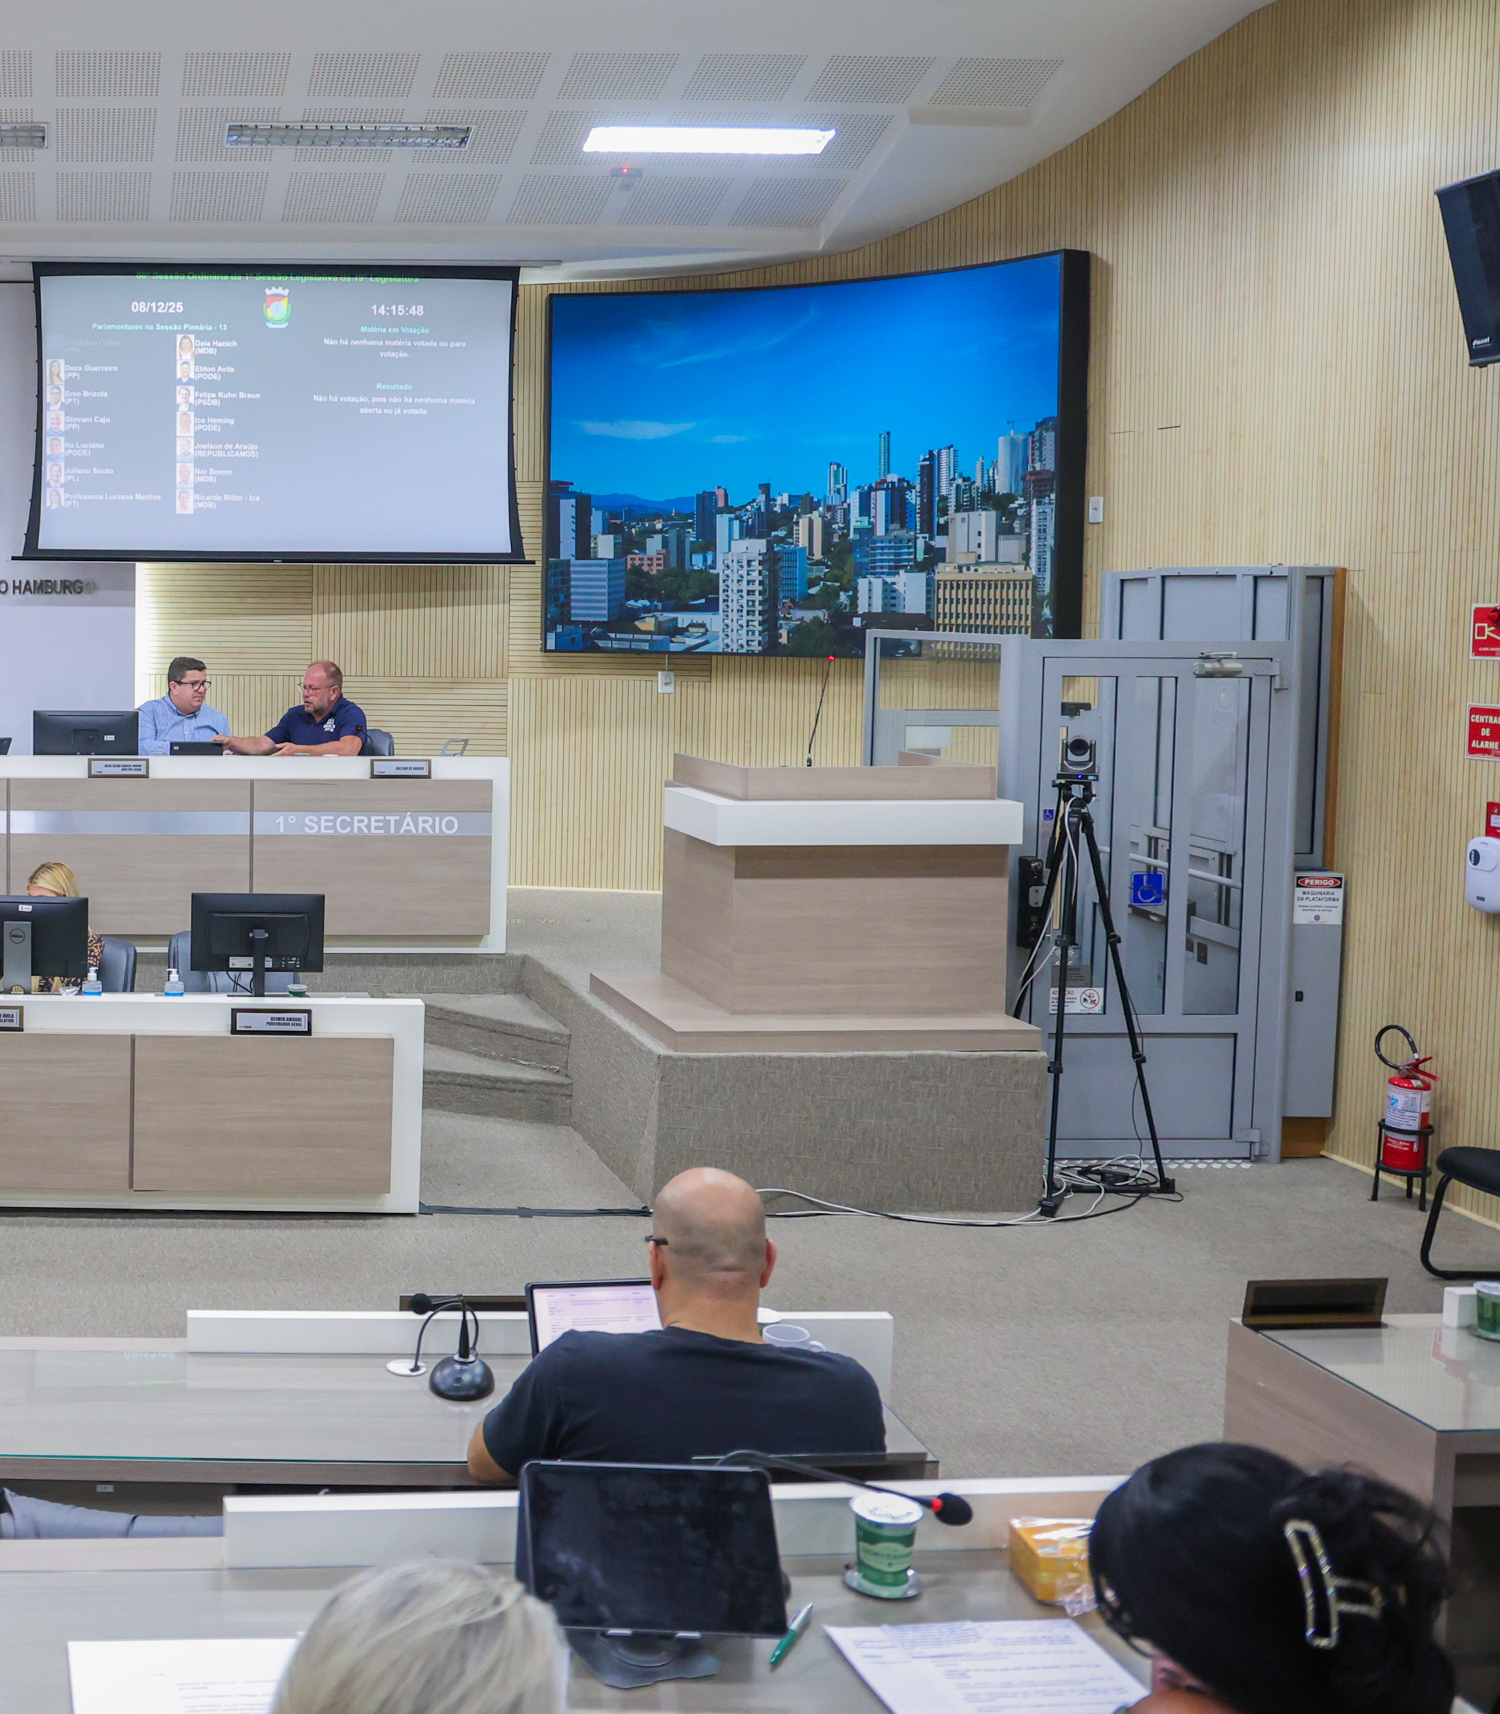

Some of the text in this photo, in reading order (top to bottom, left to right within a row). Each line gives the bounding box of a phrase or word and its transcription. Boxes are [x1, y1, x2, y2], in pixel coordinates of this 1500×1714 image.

[131, 301, 183, 314] 08/12/25
[371, 305, 424, 316] 14:15:48
[156, 323, 181, 331] Sessão
[184, 323, 212, 331] Plenária
[360, 326, 386, 334] Matéria
[401, 326, 429, 335] Votação
[213, 340, 237, 348] Hanich
[324, 337, 337, 345] Não
[194, 347, 217, 355] (MDB)
[380, 350, 410, 359] votação.
[194, 373, 221, 381] (PODE)
[195, 391, 216, 400] Felipe
[339, 395, 370, 404] votação,
[372, 396, 387, 404] pois
[65, 398, 80, 406] (PT)
[194, 399, 221, 407] (PSDB)
[394, 407, 401, 416] já
[93, 416, 110, 425] Caju
[194, 424, 221, 432] (PODE)
[234, 442, 258, 451] Araújo
[194, 450, 259, 458] (REPUBLICANOS)
[64, 475, 80, 483] (PL)
[194, 475, 217, 483] (MDB)
[194, 501, 217, 509] (MDB)
[13, 579, 95, 595] HAMBURGO
[1481, 727, 1490, 736] DE
[1471, 739, 1499, 750] ALARME
[304, 812, 459, 834] SECRETÁRIO
